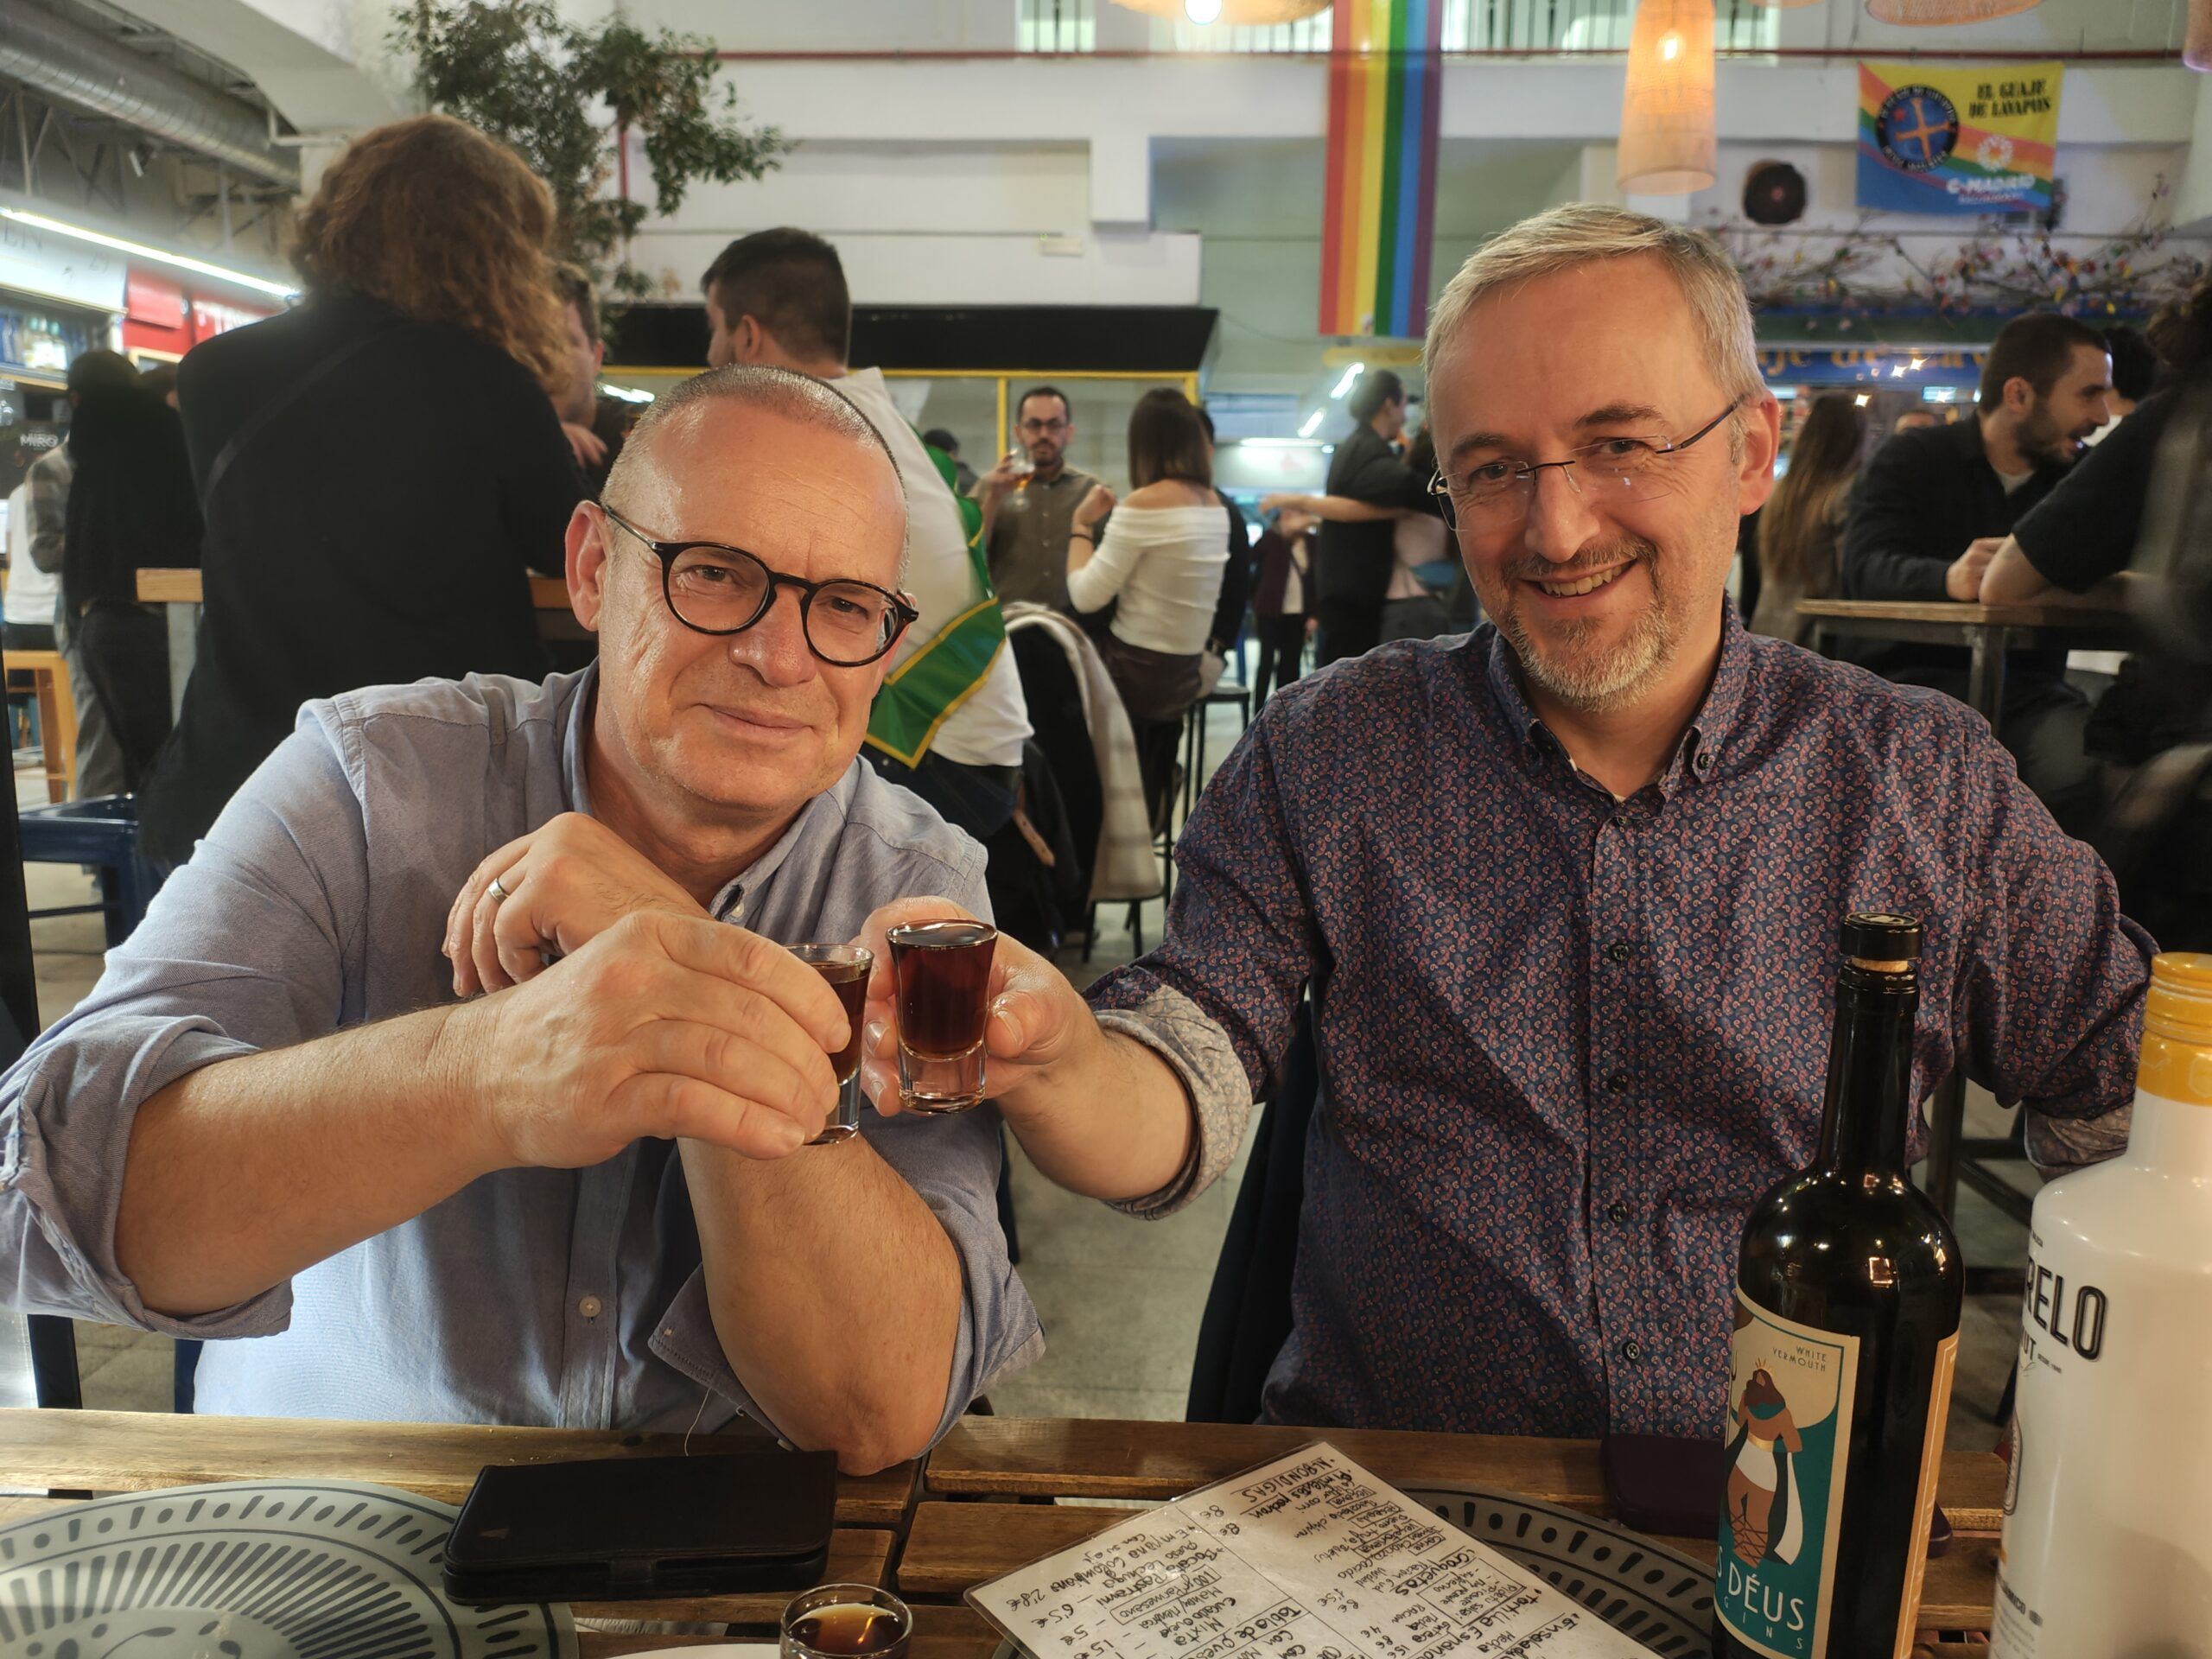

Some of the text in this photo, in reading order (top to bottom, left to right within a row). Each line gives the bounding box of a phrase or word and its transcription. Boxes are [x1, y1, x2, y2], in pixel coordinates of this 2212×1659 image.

[2024, 1255, 2108, 1360] RELO
[1772, 1348, 1827, 1372] VERMOUTH
[1796, 1345, 1827, 1363] WHITE
[1728, 1560, 1805, 1631] DÉUS
